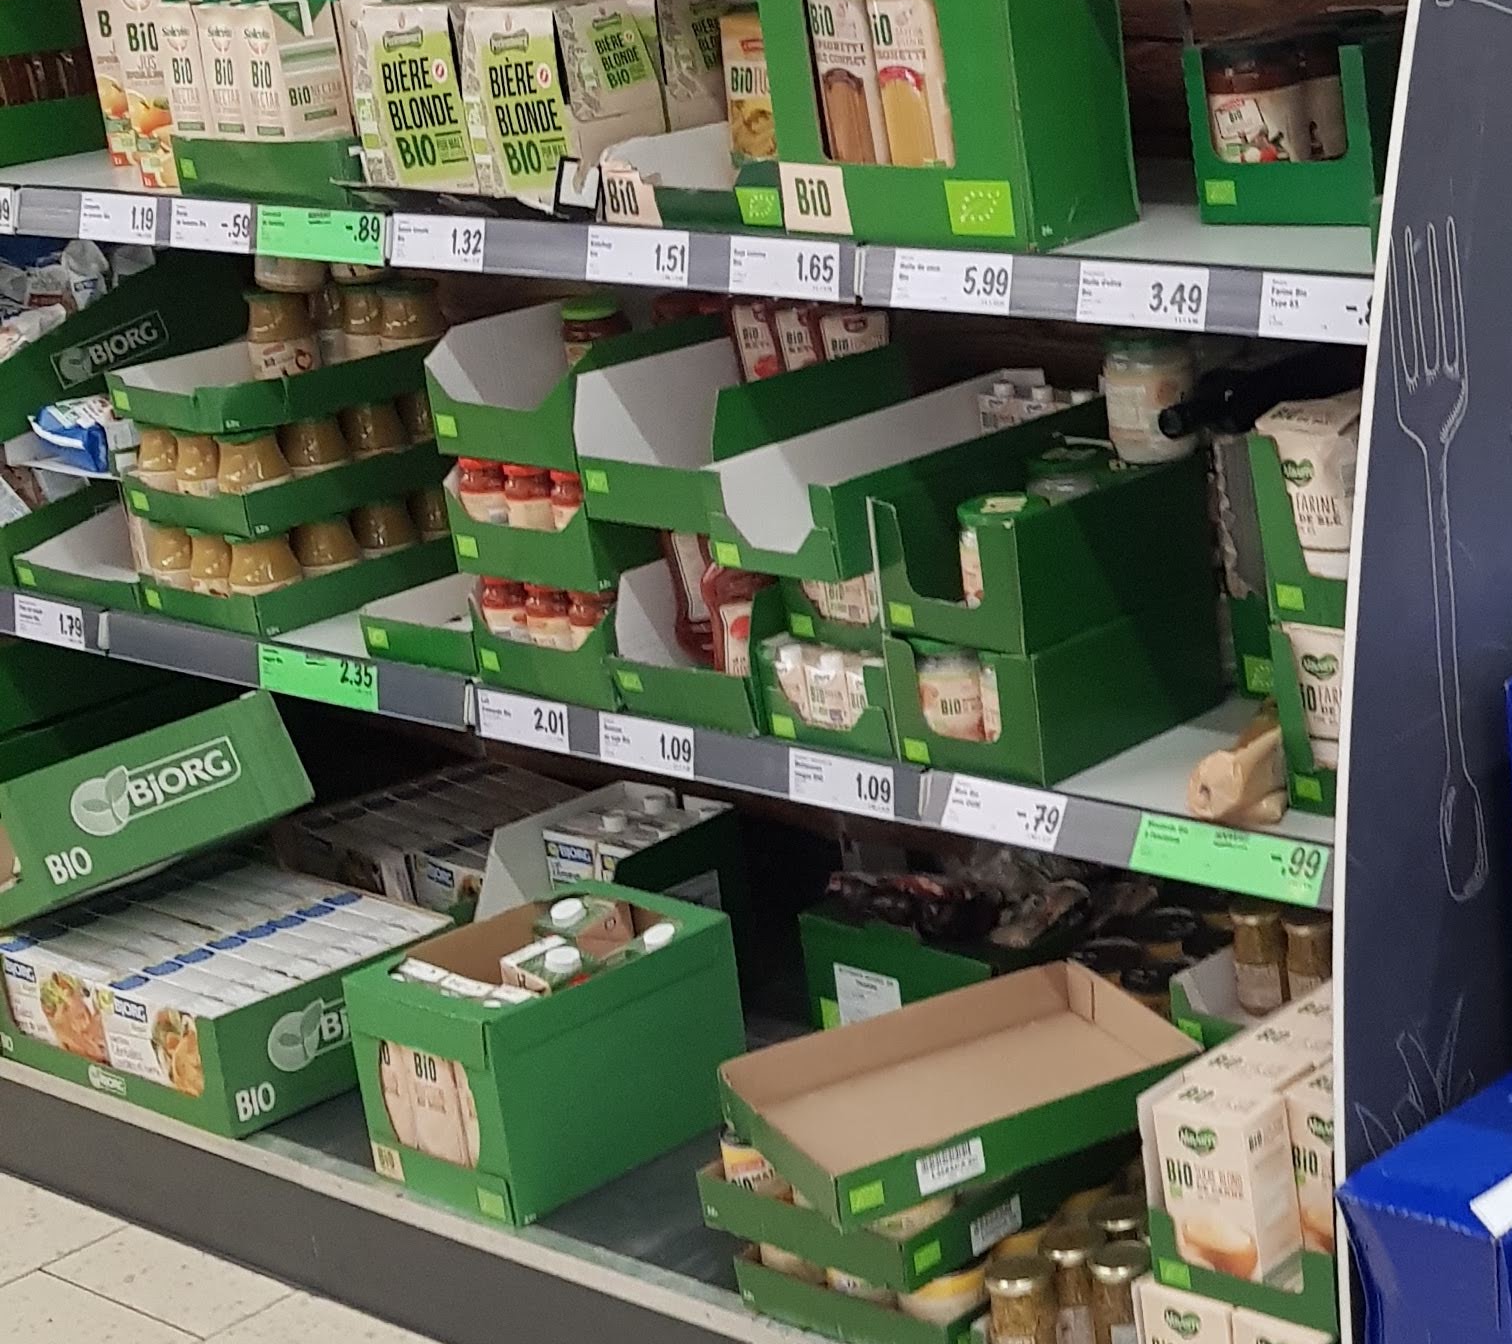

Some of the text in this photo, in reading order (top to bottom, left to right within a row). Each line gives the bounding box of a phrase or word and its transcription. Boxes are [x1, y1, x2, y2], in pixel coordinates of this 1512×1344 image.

[594, 31, 626, 56] BIÈRE
[600, 45, 641, 72] BLONDE
[381, 52, 433, 95] BIÈRE
[488, 57, 538, 99] BIÈRE
[606, 68, 632, 90] BIO
[387, 92, 459, 133] BLONDE
[494, 98, 563, 138] BLONDE
[395, 133, 437, 170] BIO
[502, 140, 542, 177] BIO
[131, 205, 155, 232] 1.19
[451, 226, 483, 256] 1.32
[654, 242, 687, 274] 1.51
[796, 251, 836, 284] 1.65
[962, 265, 1010, 298] 5.99
[1149, 281, 1203, 316] 3.49
[88, 319, 160, 364] BJORG
[1295, 493, 1338, 514] FARINE
[58, 612, 83, 638] 1.79
[340, 657, 374, 689] 2.35
[533, 706, 565, 737] 2.01
[940, 698, 962, 715] BIO
[659, 732, 693, 763] 1.09
[127, 748, 232, 809] BJORG
[855, 771, 892, 804] 1.09
[44, 845, 93, 887] BIO
[113, 997, 148, 1023] BJORG
[235, 1082, 277, 1124] BIO
[1166, 1156, 1194, 1188] BIO
[1291, 1145, 1319, 1176] BIO
